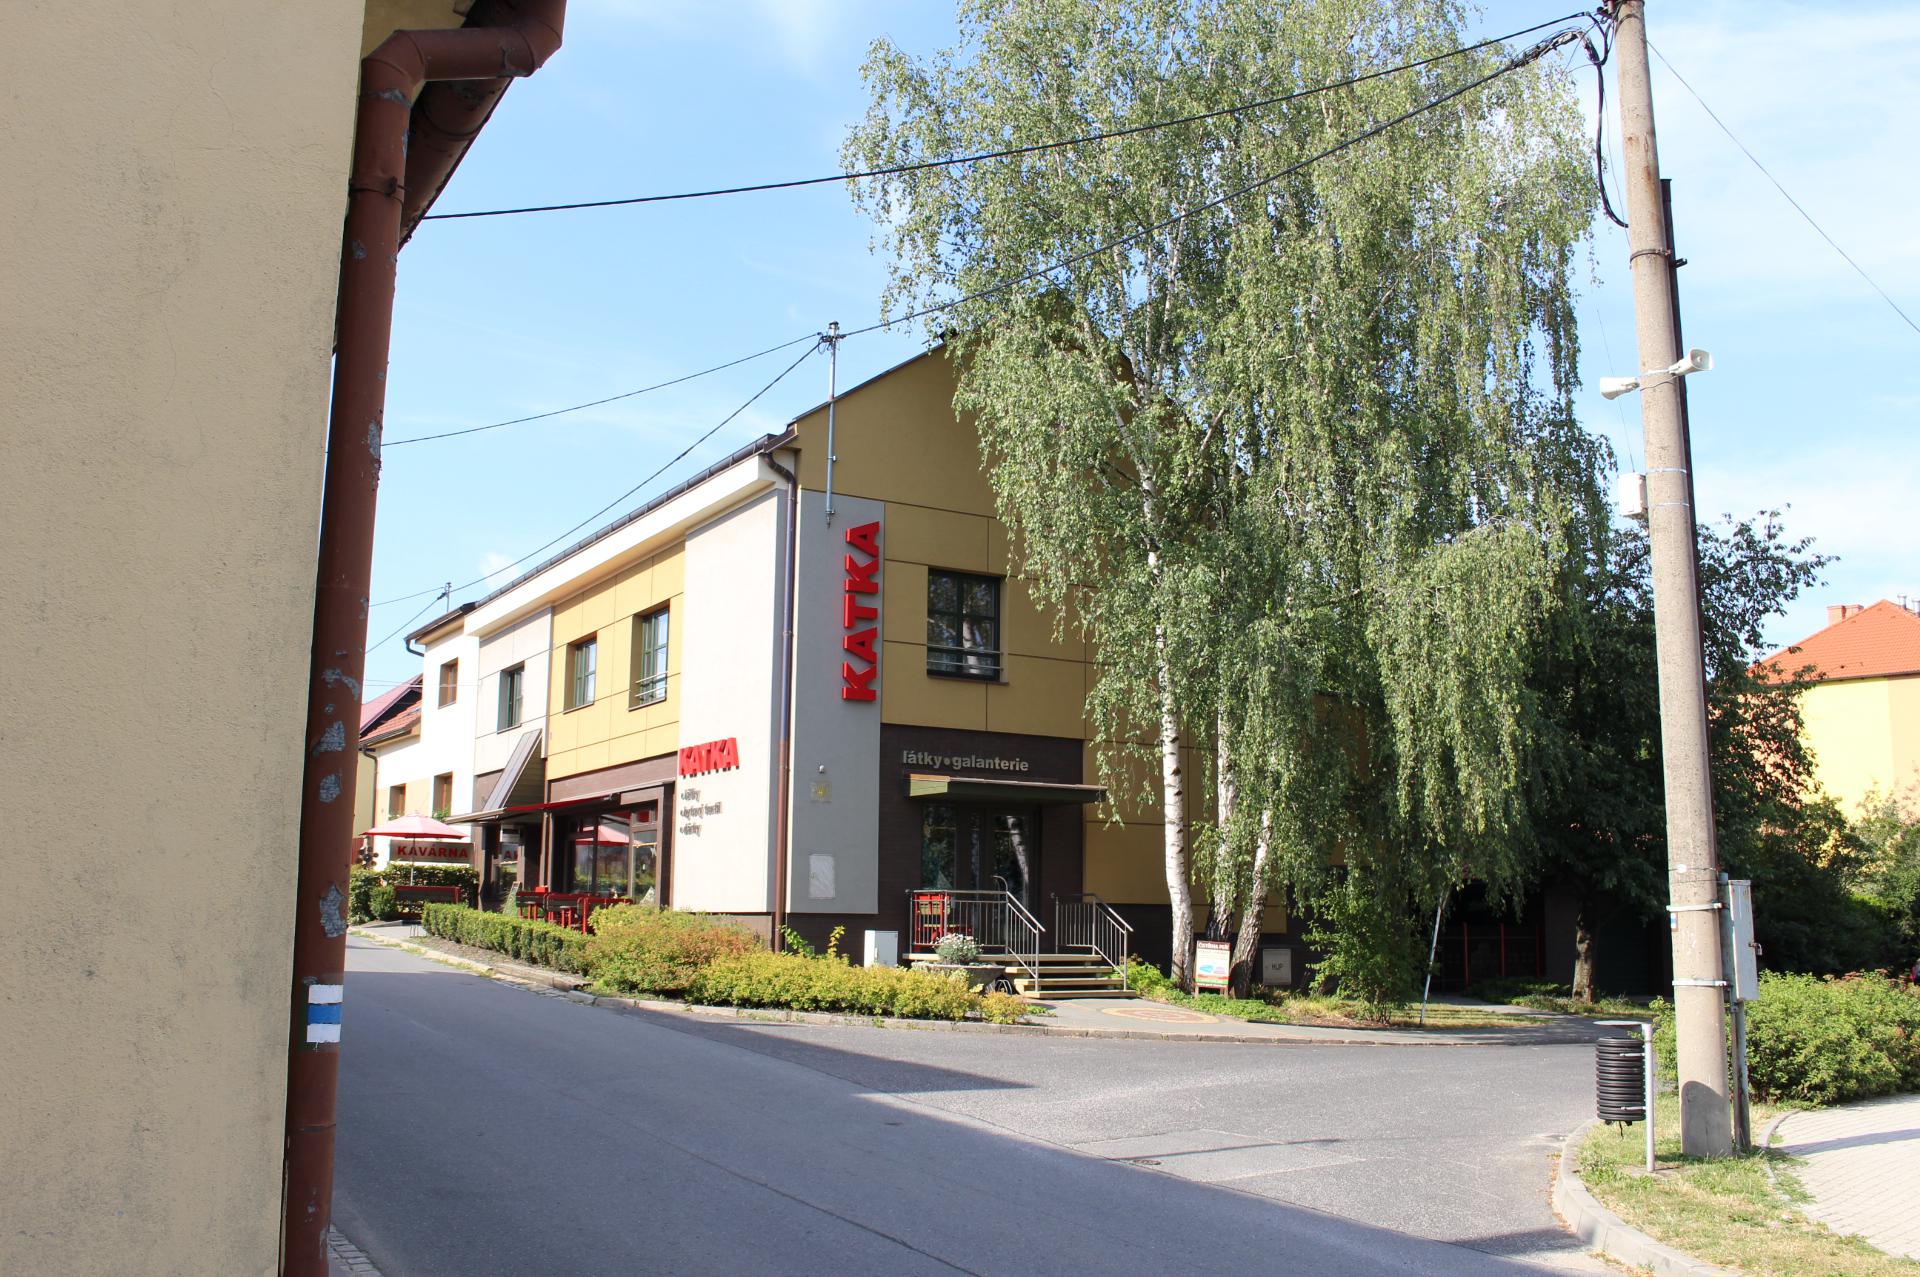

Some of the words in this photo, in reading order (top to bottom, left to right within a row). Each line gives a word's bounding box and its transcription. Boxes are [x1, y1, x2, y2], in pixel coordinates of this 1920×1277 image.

[842, 520, 880, 702] KATKA
[679, 737, 739, 777] KATKA
[902, 750, 943, 769] látky
[952, 755, 1029, 771] galanterie
[397, 844, 468, 858] KAVÁRNA
